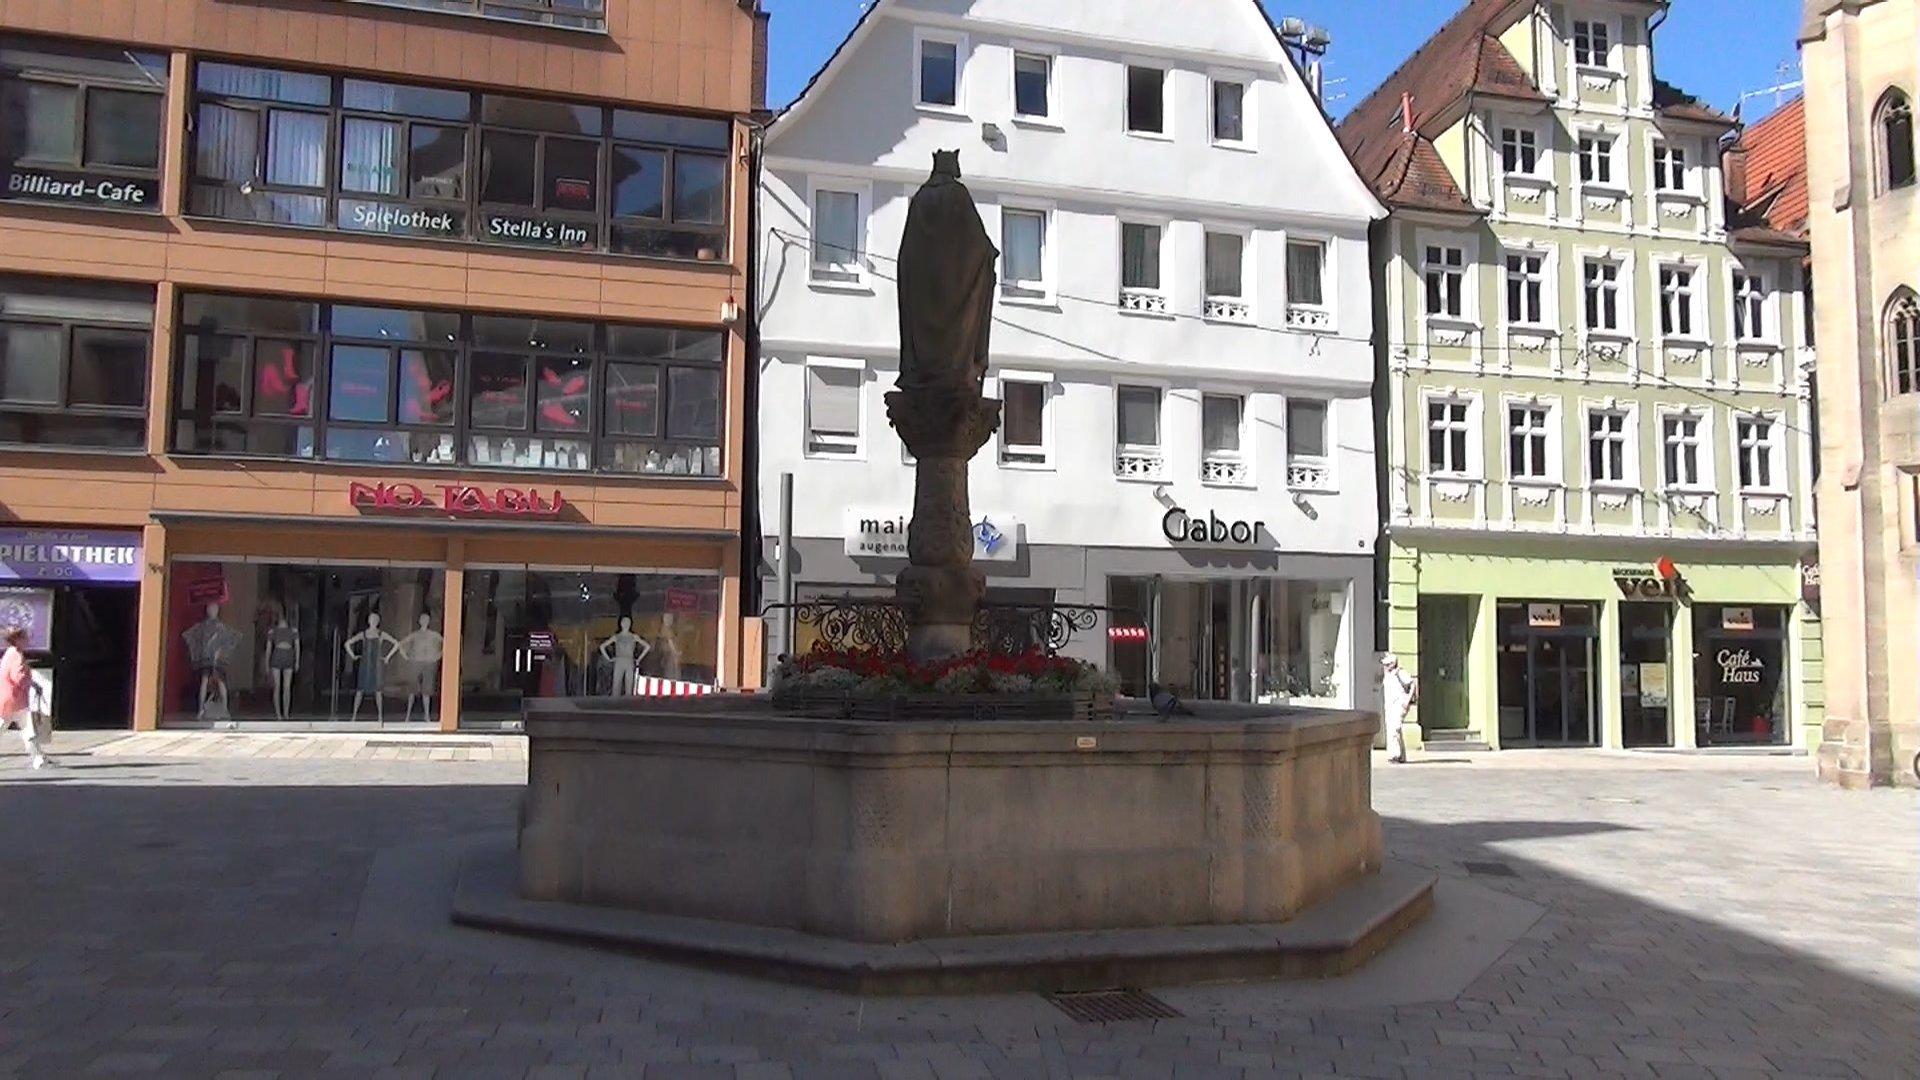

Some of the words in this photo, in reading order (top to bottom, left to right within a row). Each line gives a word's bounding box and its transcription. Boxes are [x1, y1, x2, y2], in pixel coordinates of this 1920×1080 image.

[9, 174, 144, 202] Billiard-Cafe
[353, 206, 453, 230] Spielothek
[490, 218, 554, 239] Stella's
[560, 223, 588, 242] Inn
[349, 481, 424, 507] NO
[433, 480, 565, 515] TABU
[860, 516, 909, 534] mai
[1162, 507, 1265, 544] Gabor
[859, 542, 906, 553] augeno
[1717, 649, 1750, 668] Café
[1722, 667, 1760, 683] Haus
